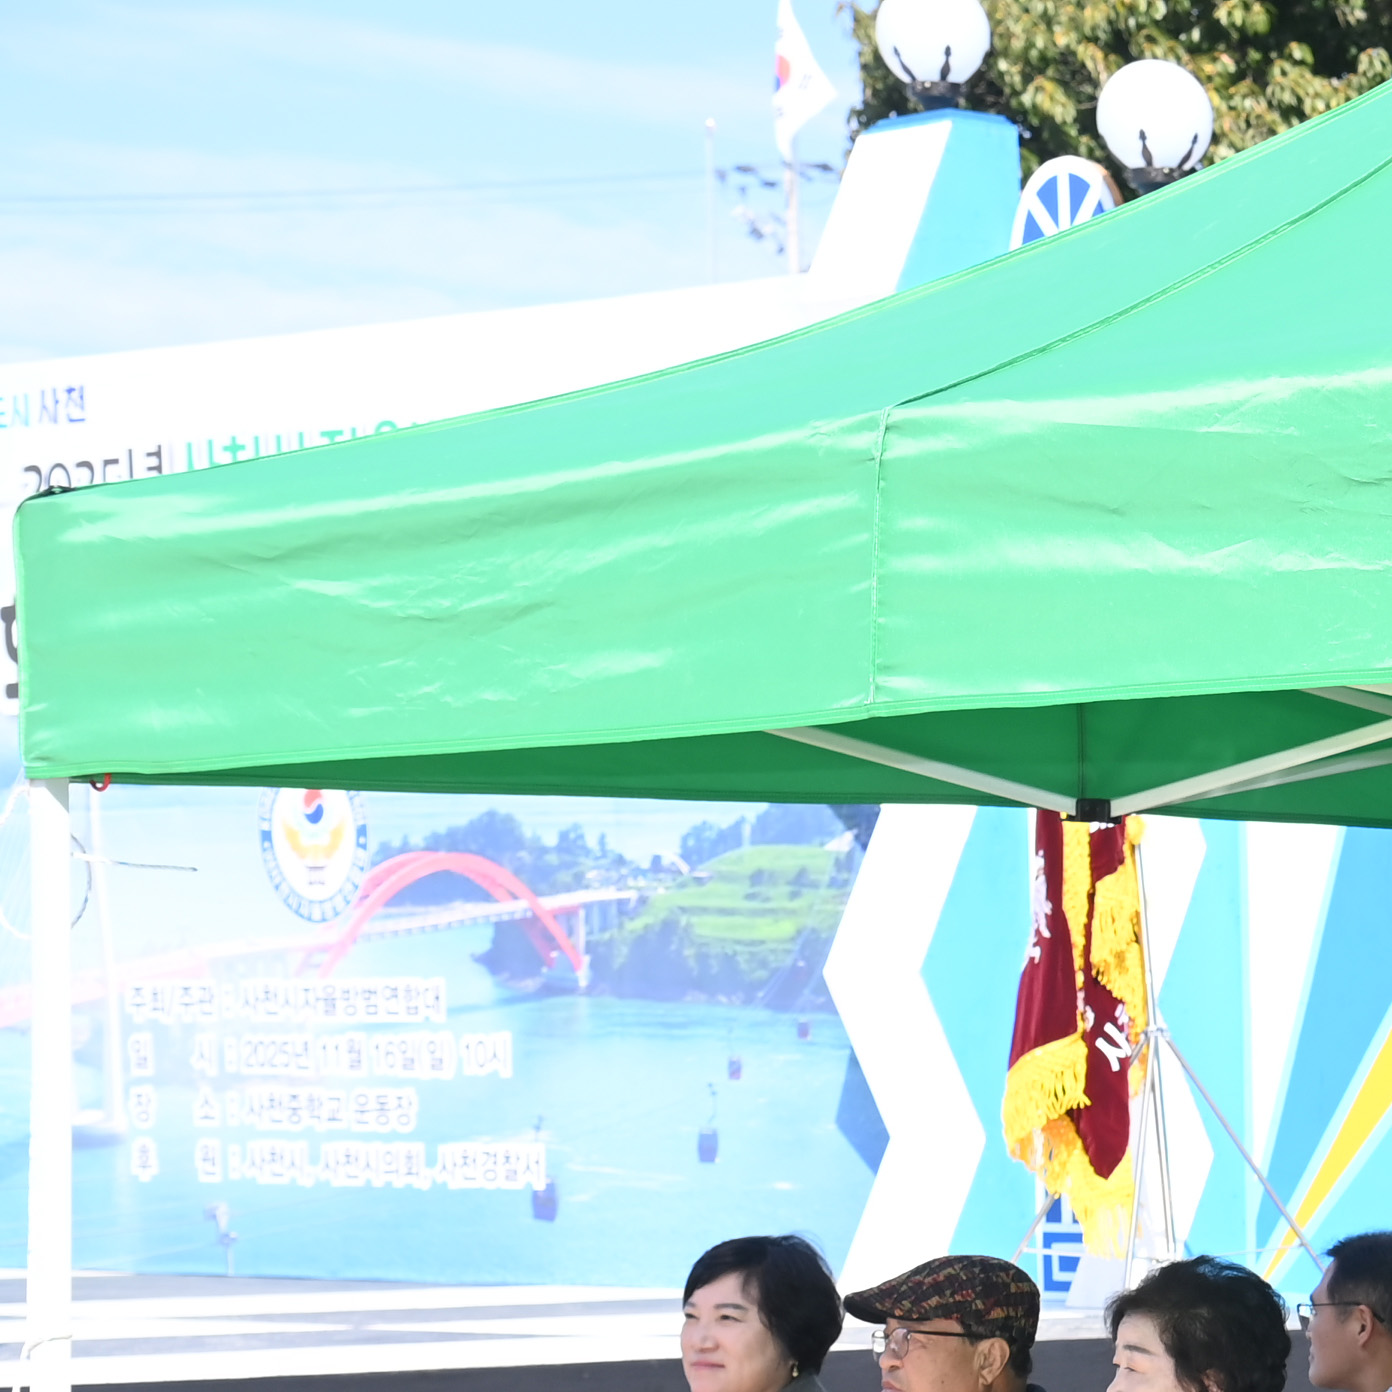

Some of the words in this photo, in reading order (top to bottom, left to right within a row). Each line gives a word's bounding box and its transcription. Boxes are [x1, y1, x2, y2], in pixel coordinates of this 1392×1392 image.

[129, 985, 215, 1017] 주최/주관
[241, 983, 441, 1018] 사천시자율방범연합대
[244, 1038, 311, 1070] 2025년
[320, 1038, 362, 1071] 11월
[374, 1038, 455, 1073] 16일(일)
[463, 1038, 510, 1074] 10시
[246, 1092, 343, 1126] 사천중학교
[354, 1093, 414, 1127] 운동장
[438, 1150, 543, 1184] 사천경찰서
